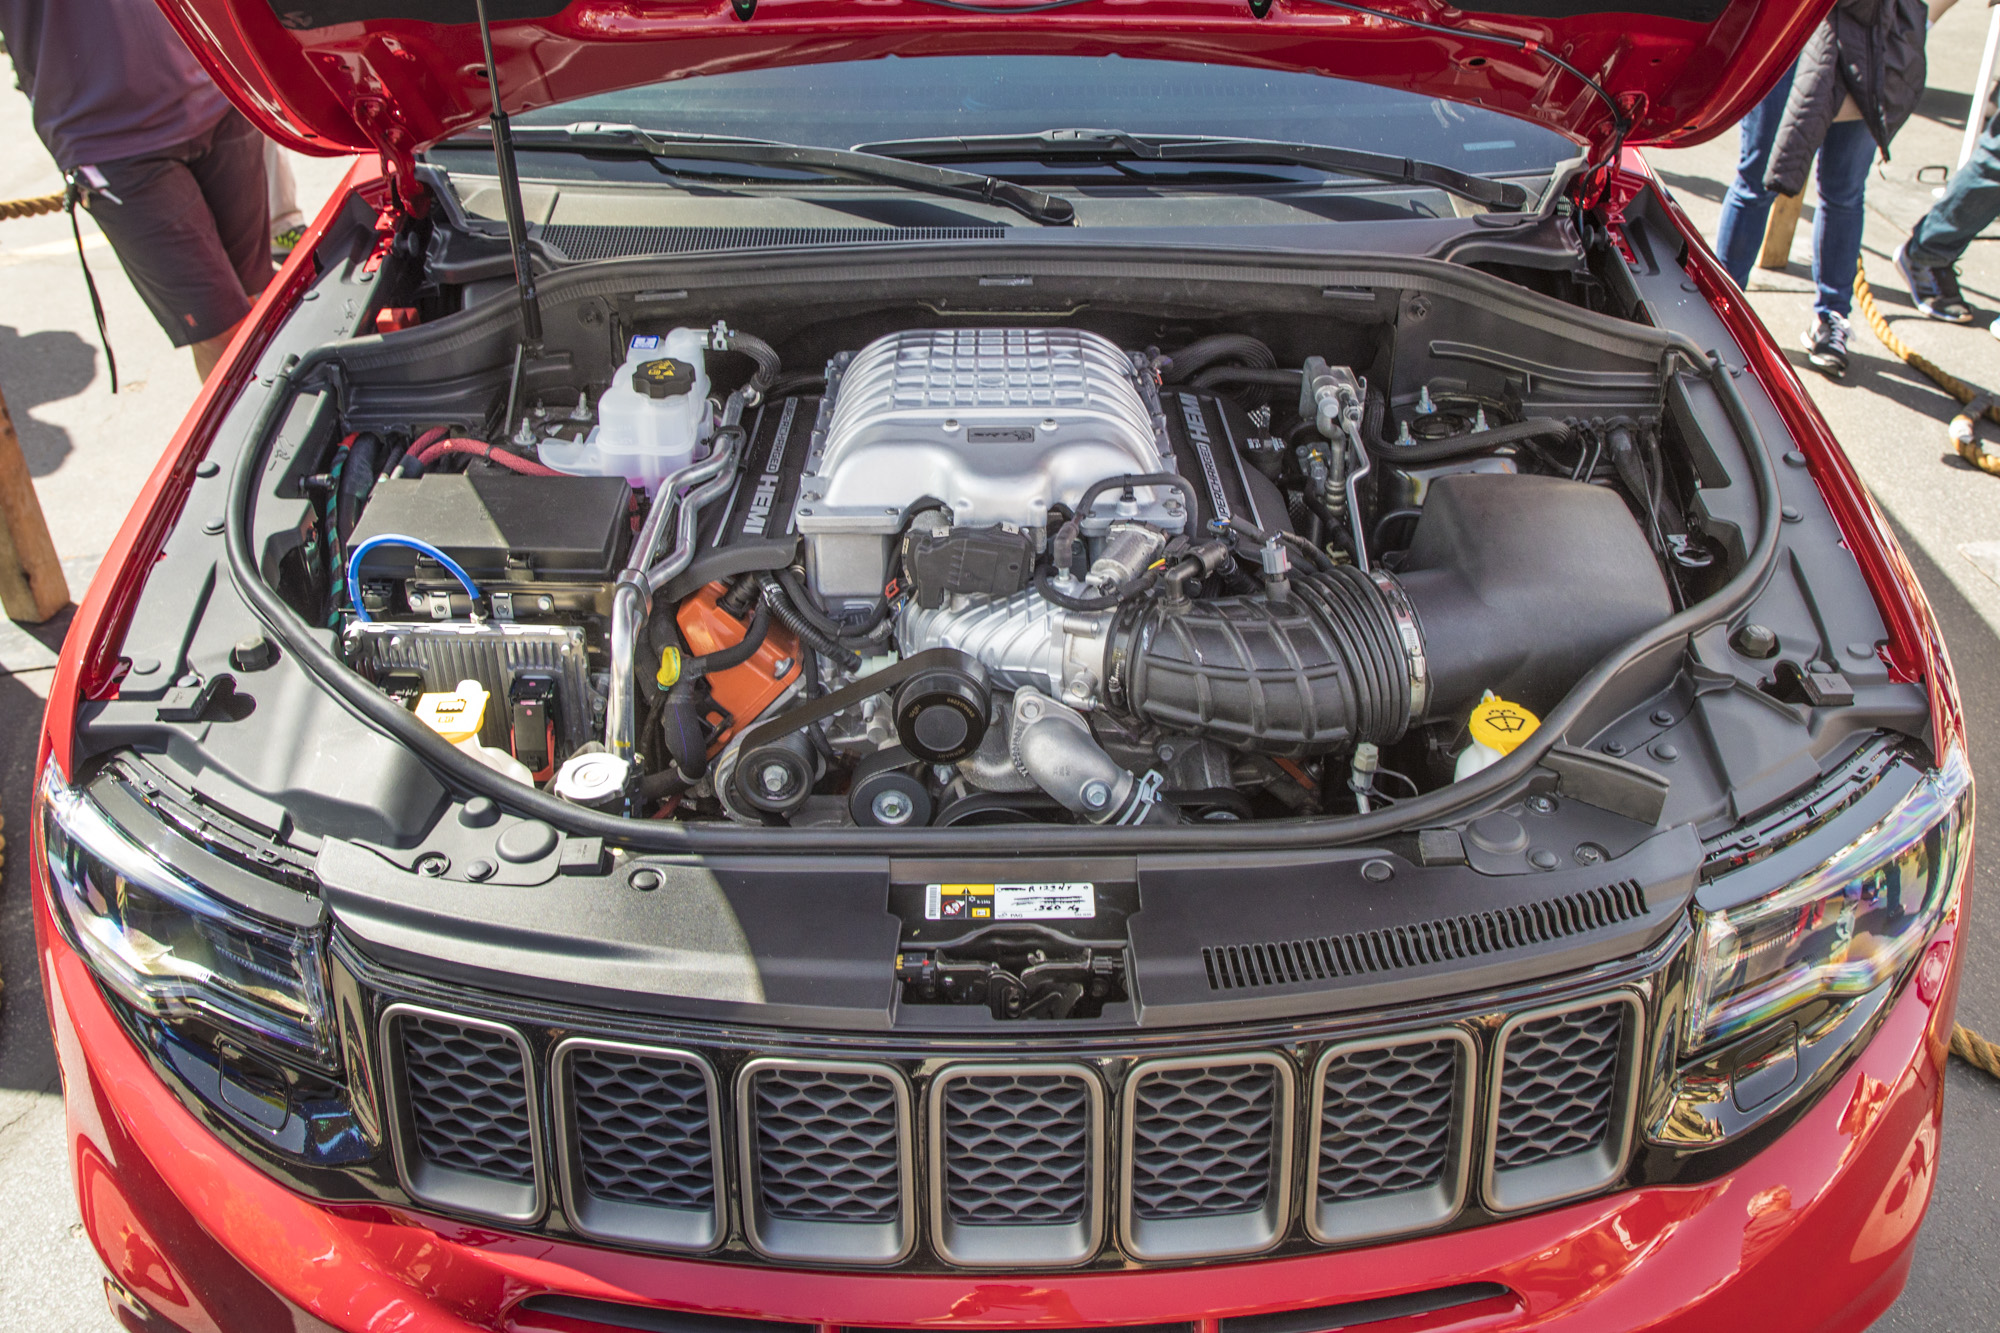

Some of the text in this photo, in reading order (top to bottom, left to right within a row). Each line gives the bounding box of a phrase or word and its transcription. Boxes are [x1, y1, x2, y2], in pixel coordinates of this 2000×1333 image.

[767, 398, 797, 472] SUPERCHARGED
[1179, 392, 1210, 443] HEMI
[743, 474, 779, 533] HEMI
[1198, 444, 1229, 518] PERCHARGED
